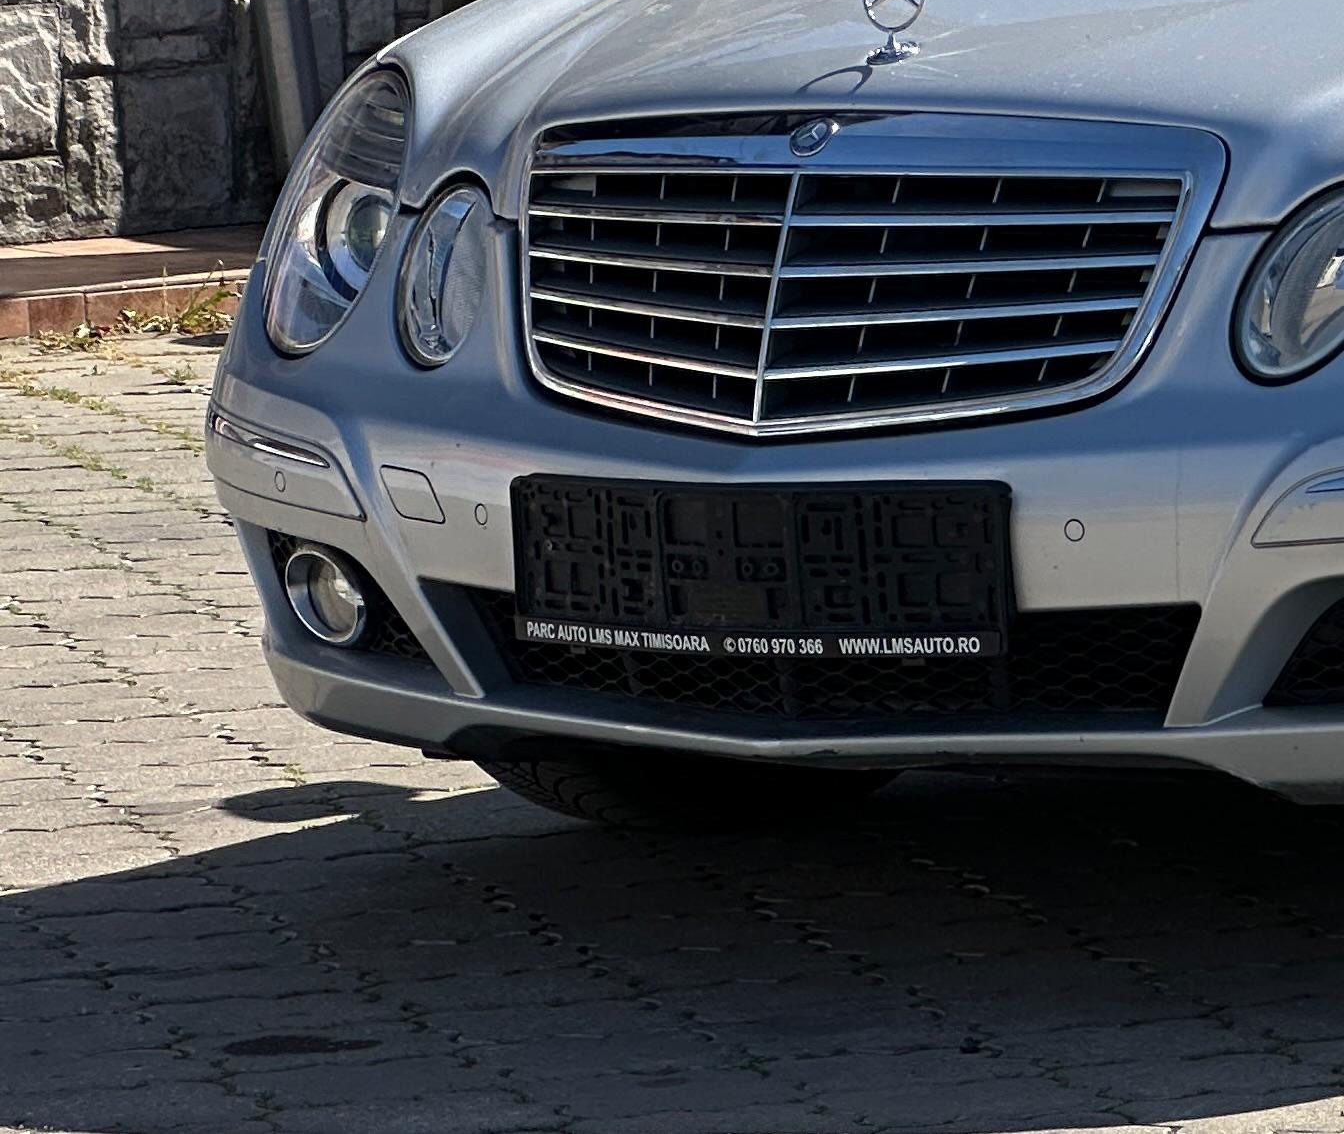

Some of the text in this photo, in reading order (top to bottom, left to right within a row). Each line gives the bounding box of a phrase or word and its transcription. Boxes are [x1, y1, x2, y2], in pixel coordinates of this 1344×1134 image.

[526, 621, 981, 654] PARC AUTO LMS MAX TIMISOARA 0760 970 366 WWW.LMSAUTO.RO
